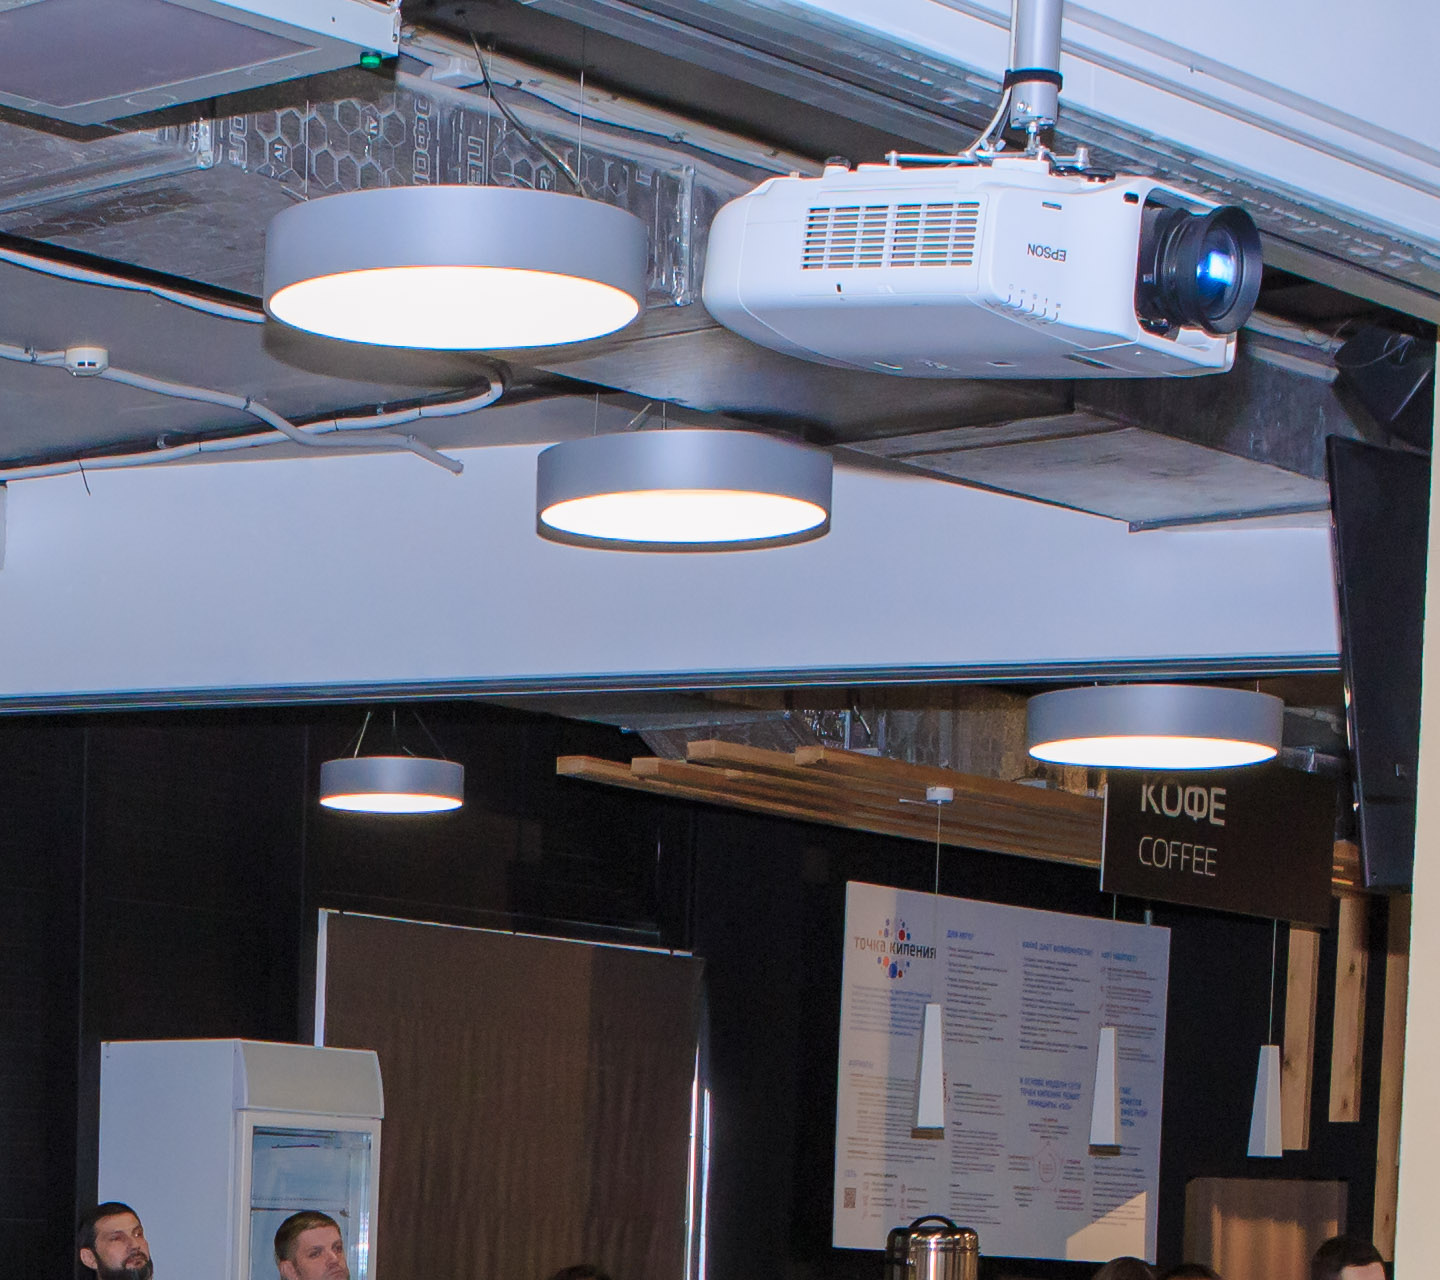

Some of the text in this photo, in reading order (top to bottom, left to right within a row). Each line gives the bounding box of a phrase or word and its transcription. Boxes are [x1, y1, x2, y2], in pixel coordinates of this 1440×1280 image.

[1027, 243, 1067, 262] EPSON
[1141, 783, 1226, 826] КОФЕ
[1139, 836, 1218, 877] COFFEE
[853, 936, 937, 960] точка кипения
